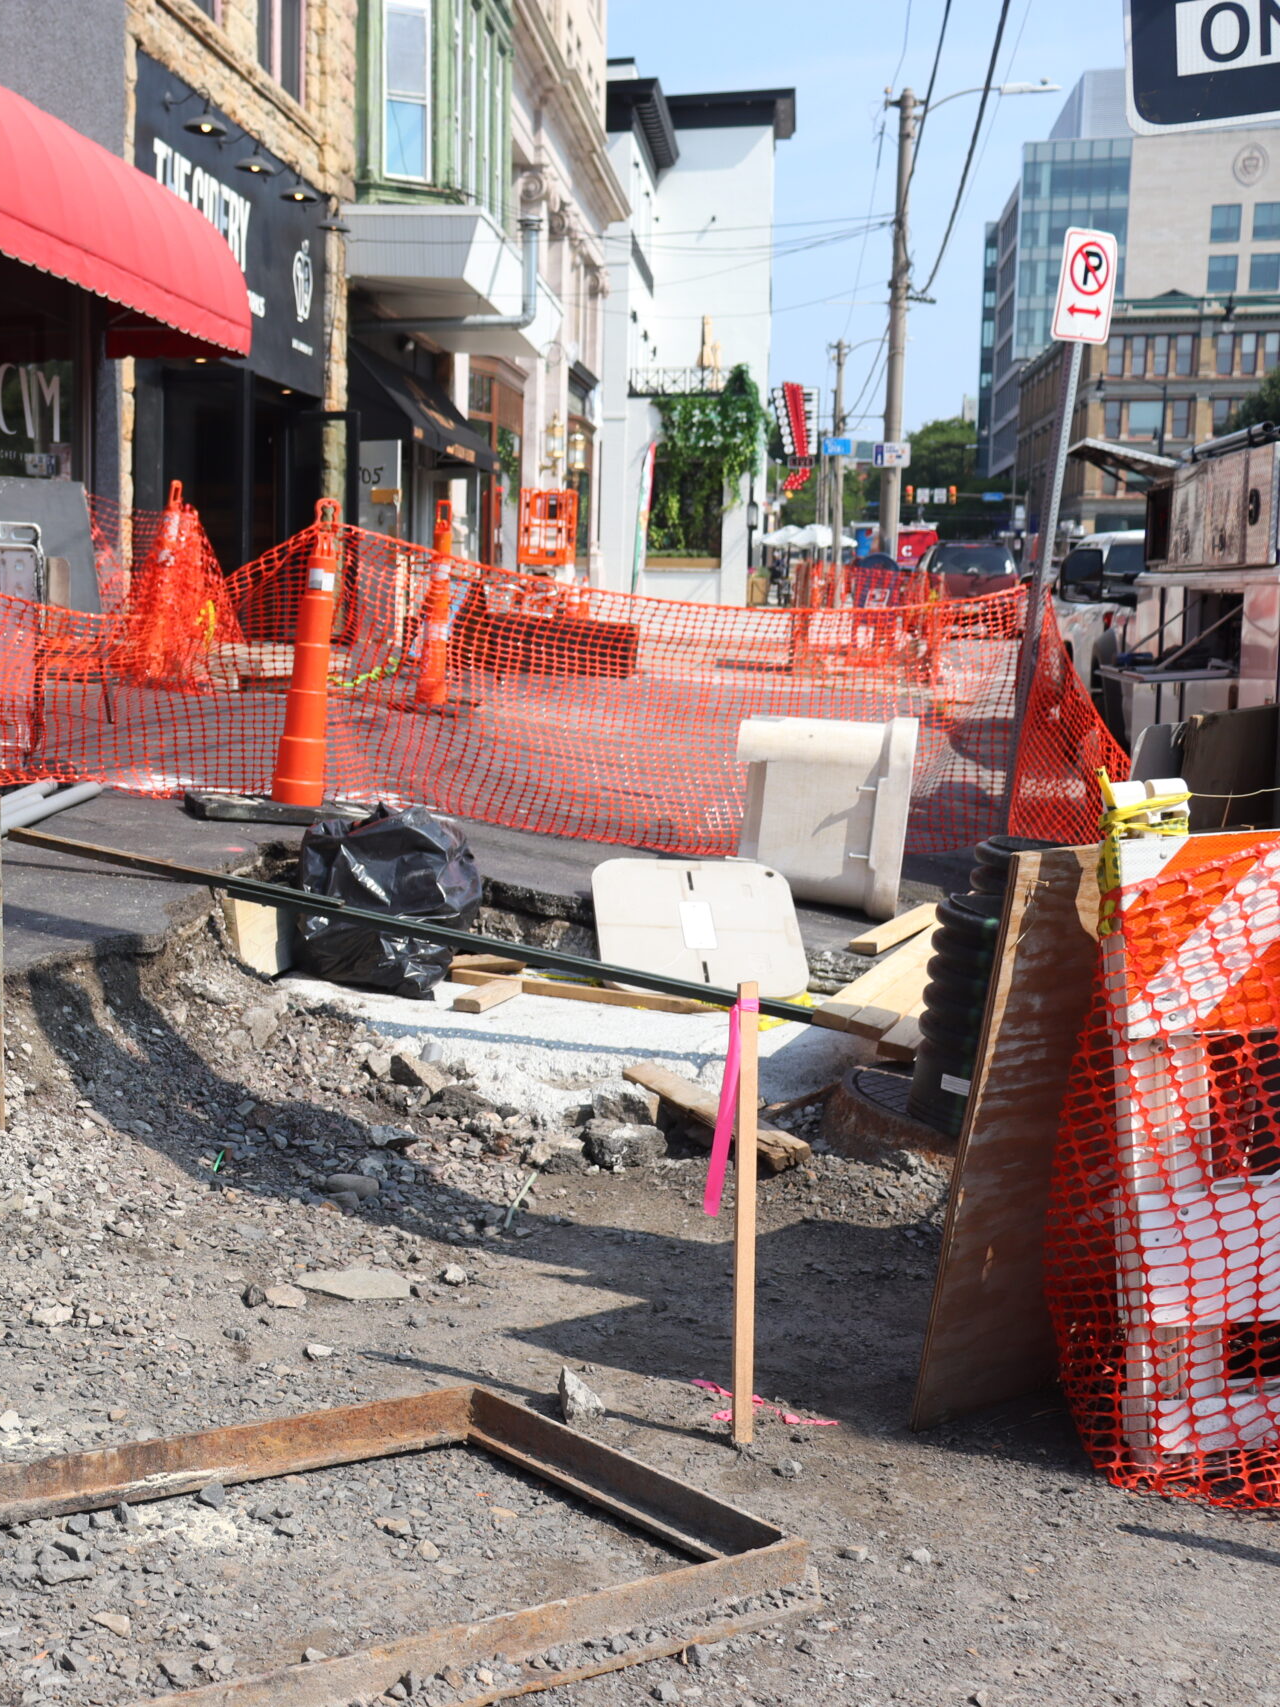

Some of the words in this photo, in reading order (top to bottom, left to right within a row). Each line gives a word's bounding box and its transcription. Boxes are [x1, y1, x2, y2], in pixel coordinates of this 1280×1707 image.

[153, 137, 191, 203] THE
[192, 166, 251, 273] CIDERY
[359, 466, 384, 485] 05
